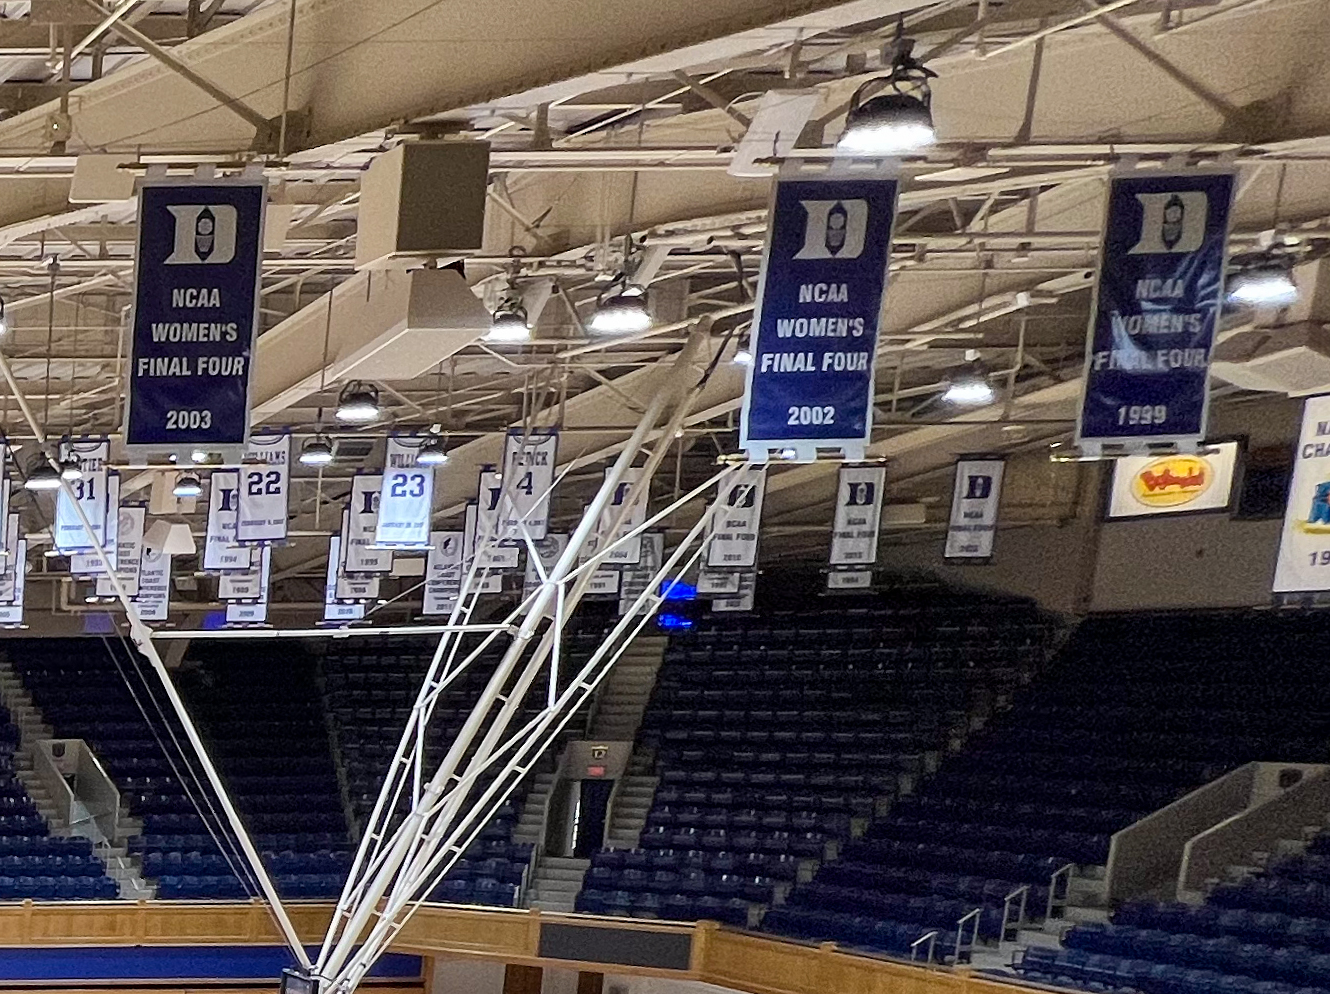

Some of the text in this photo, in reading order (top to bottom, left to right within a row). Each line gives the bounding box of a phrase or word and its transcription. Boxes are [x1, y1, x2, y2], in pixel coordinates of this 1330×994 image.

[172, 288, 221, 308] NCAA
[799, 283, 849, 304] NCAA
[1135, 279, 1185, 300] NCAA
[151, 323, 238, 342] WOMEN'S
[776, 318, 865, 339] WOMEN'S
[138, 356, 244, 377] FINAL FOUR
[760, 352, 868, 373] FINAL FOUR
[1157, 349, 1207, 370] FOUR
[165, 410, 212, 430] 2003
[787, 406, 835, 426] 2002
[1117, 404, 1168, 427] 1999
[247, 471, 282, 496] 22
[390, 473, 426, 498] 23
[515, 471, 534, 496] 4
[1308, 550, 1330, 568] 19
